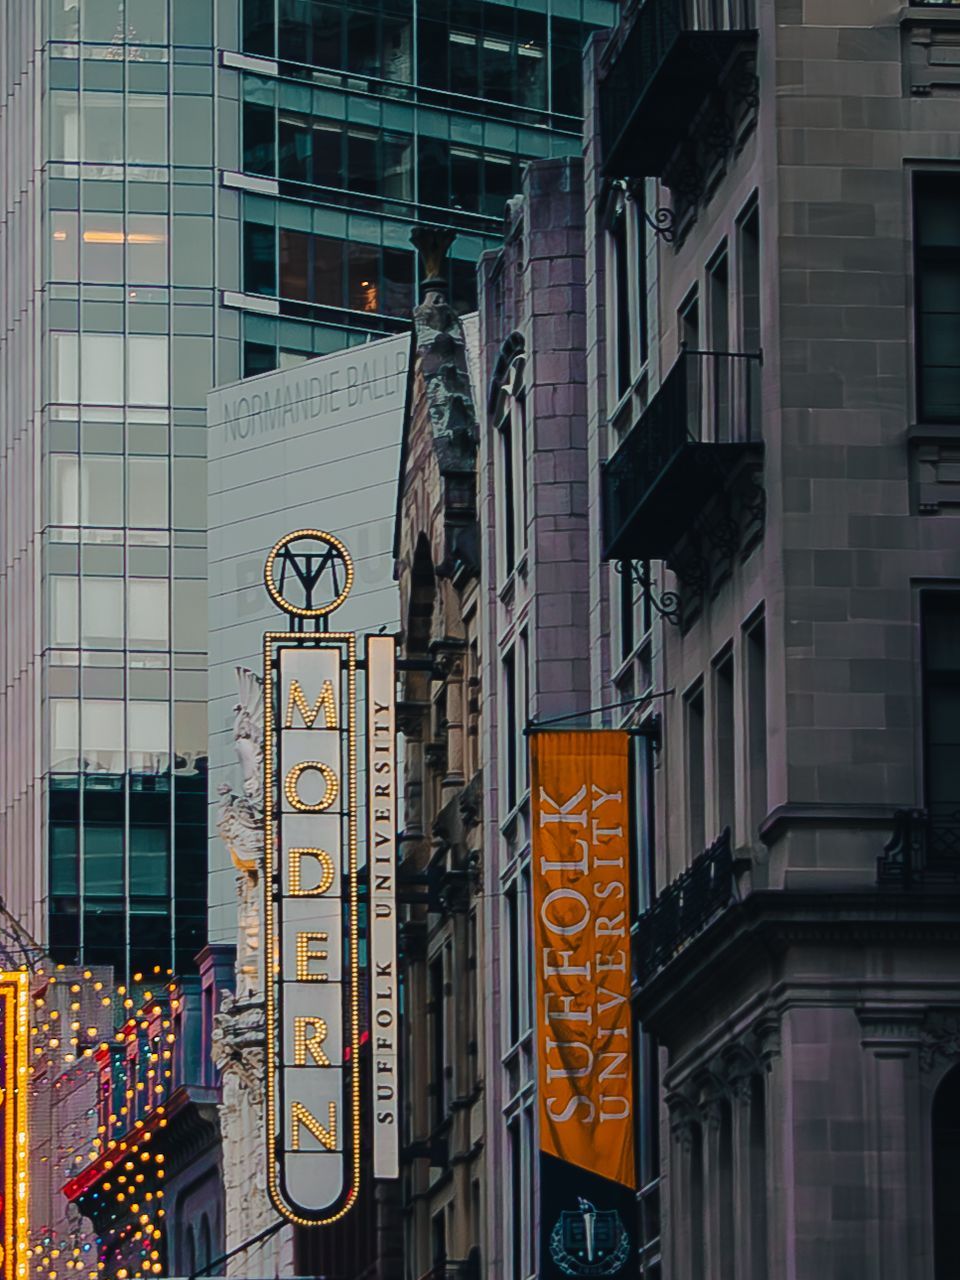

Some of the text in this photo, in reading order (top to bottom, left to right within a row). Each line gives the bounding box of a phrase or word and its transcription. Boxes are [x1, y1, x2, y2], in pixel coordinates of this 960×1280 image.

[224, 370, 341, 442] NORMANDIE
[284, 679, 338, 1152] MODERN
[374, 699, 393, 1125] SUFFOLK UNIVERSITY
[539, 784, 596, 1125] SUFFOLK
[590, 782, 631, 1124] UNIVERSITY
